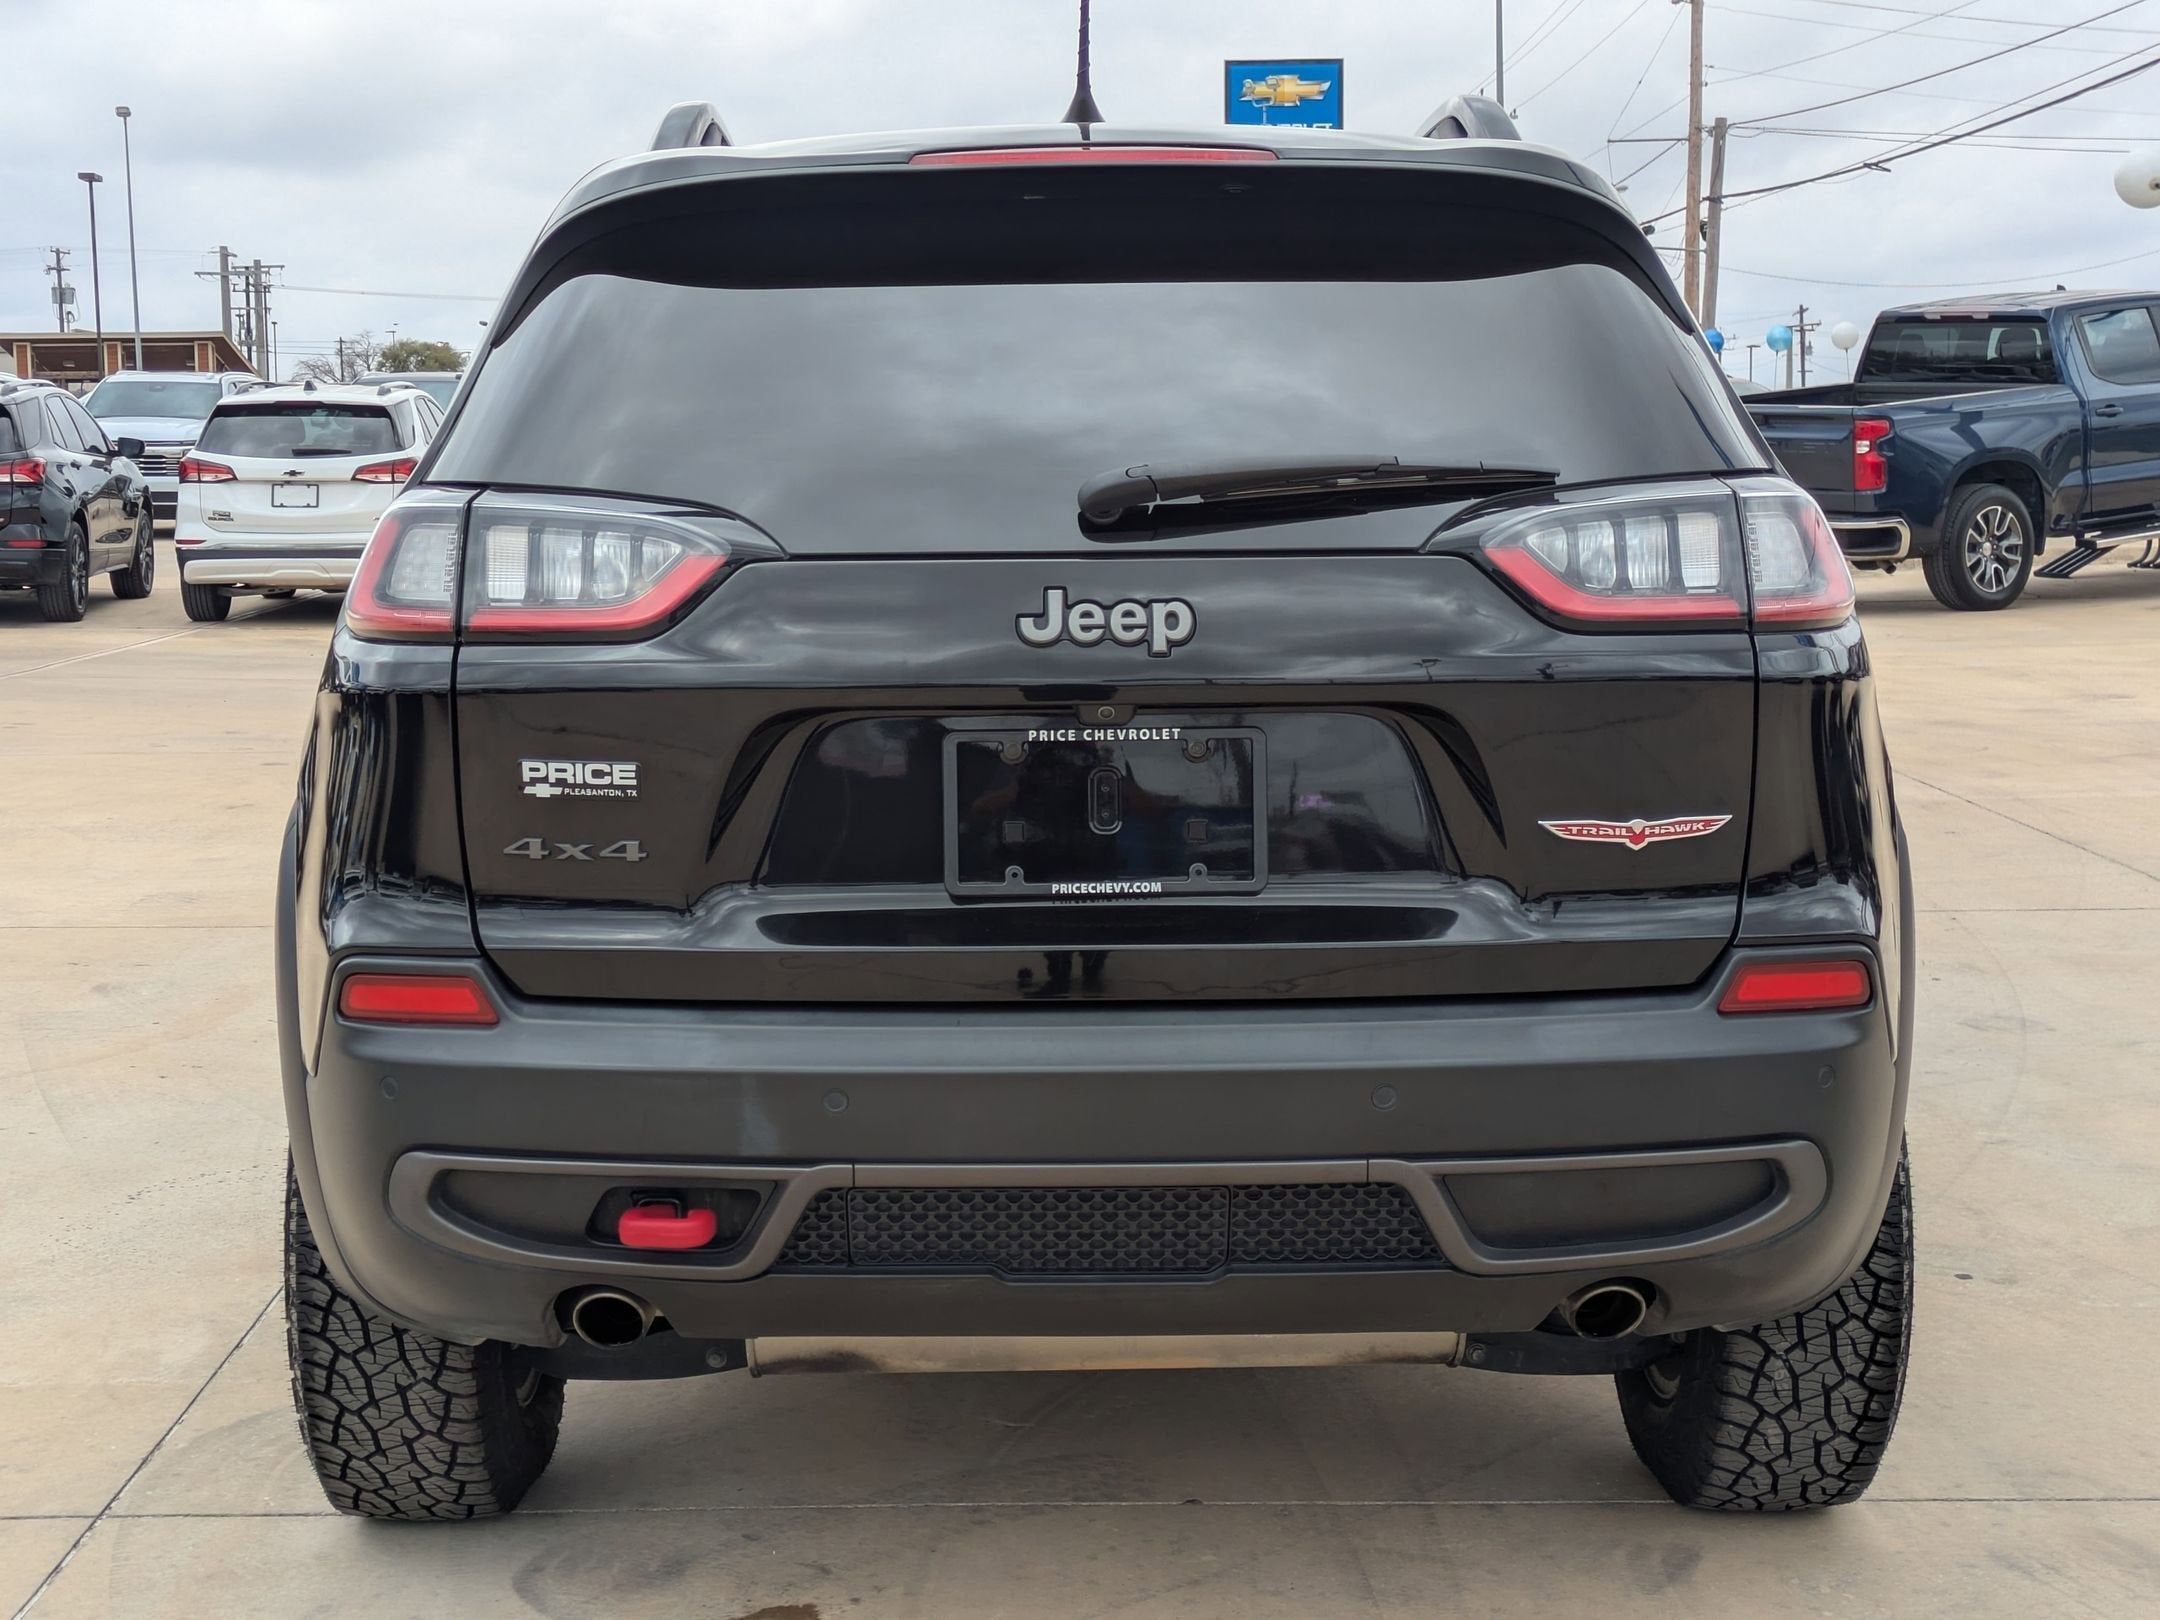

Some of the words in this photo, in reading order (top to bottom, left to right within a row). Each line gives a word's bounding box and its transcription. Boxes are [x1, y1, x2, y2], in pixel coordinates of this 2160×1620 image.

[1017, 586, 1195, 656] Jeep
[1028, 729, 1076, 742] PRICE
[1083, 728, 1181, 741] CHEVROLET
[521, 761, 638, 785] PRICE
[563, 788, 625, 797] PLEASANTON,
[503, 837, 648, 862] 4x4
[1051, 882, 1162, 895] PRICECHEVY.COM
